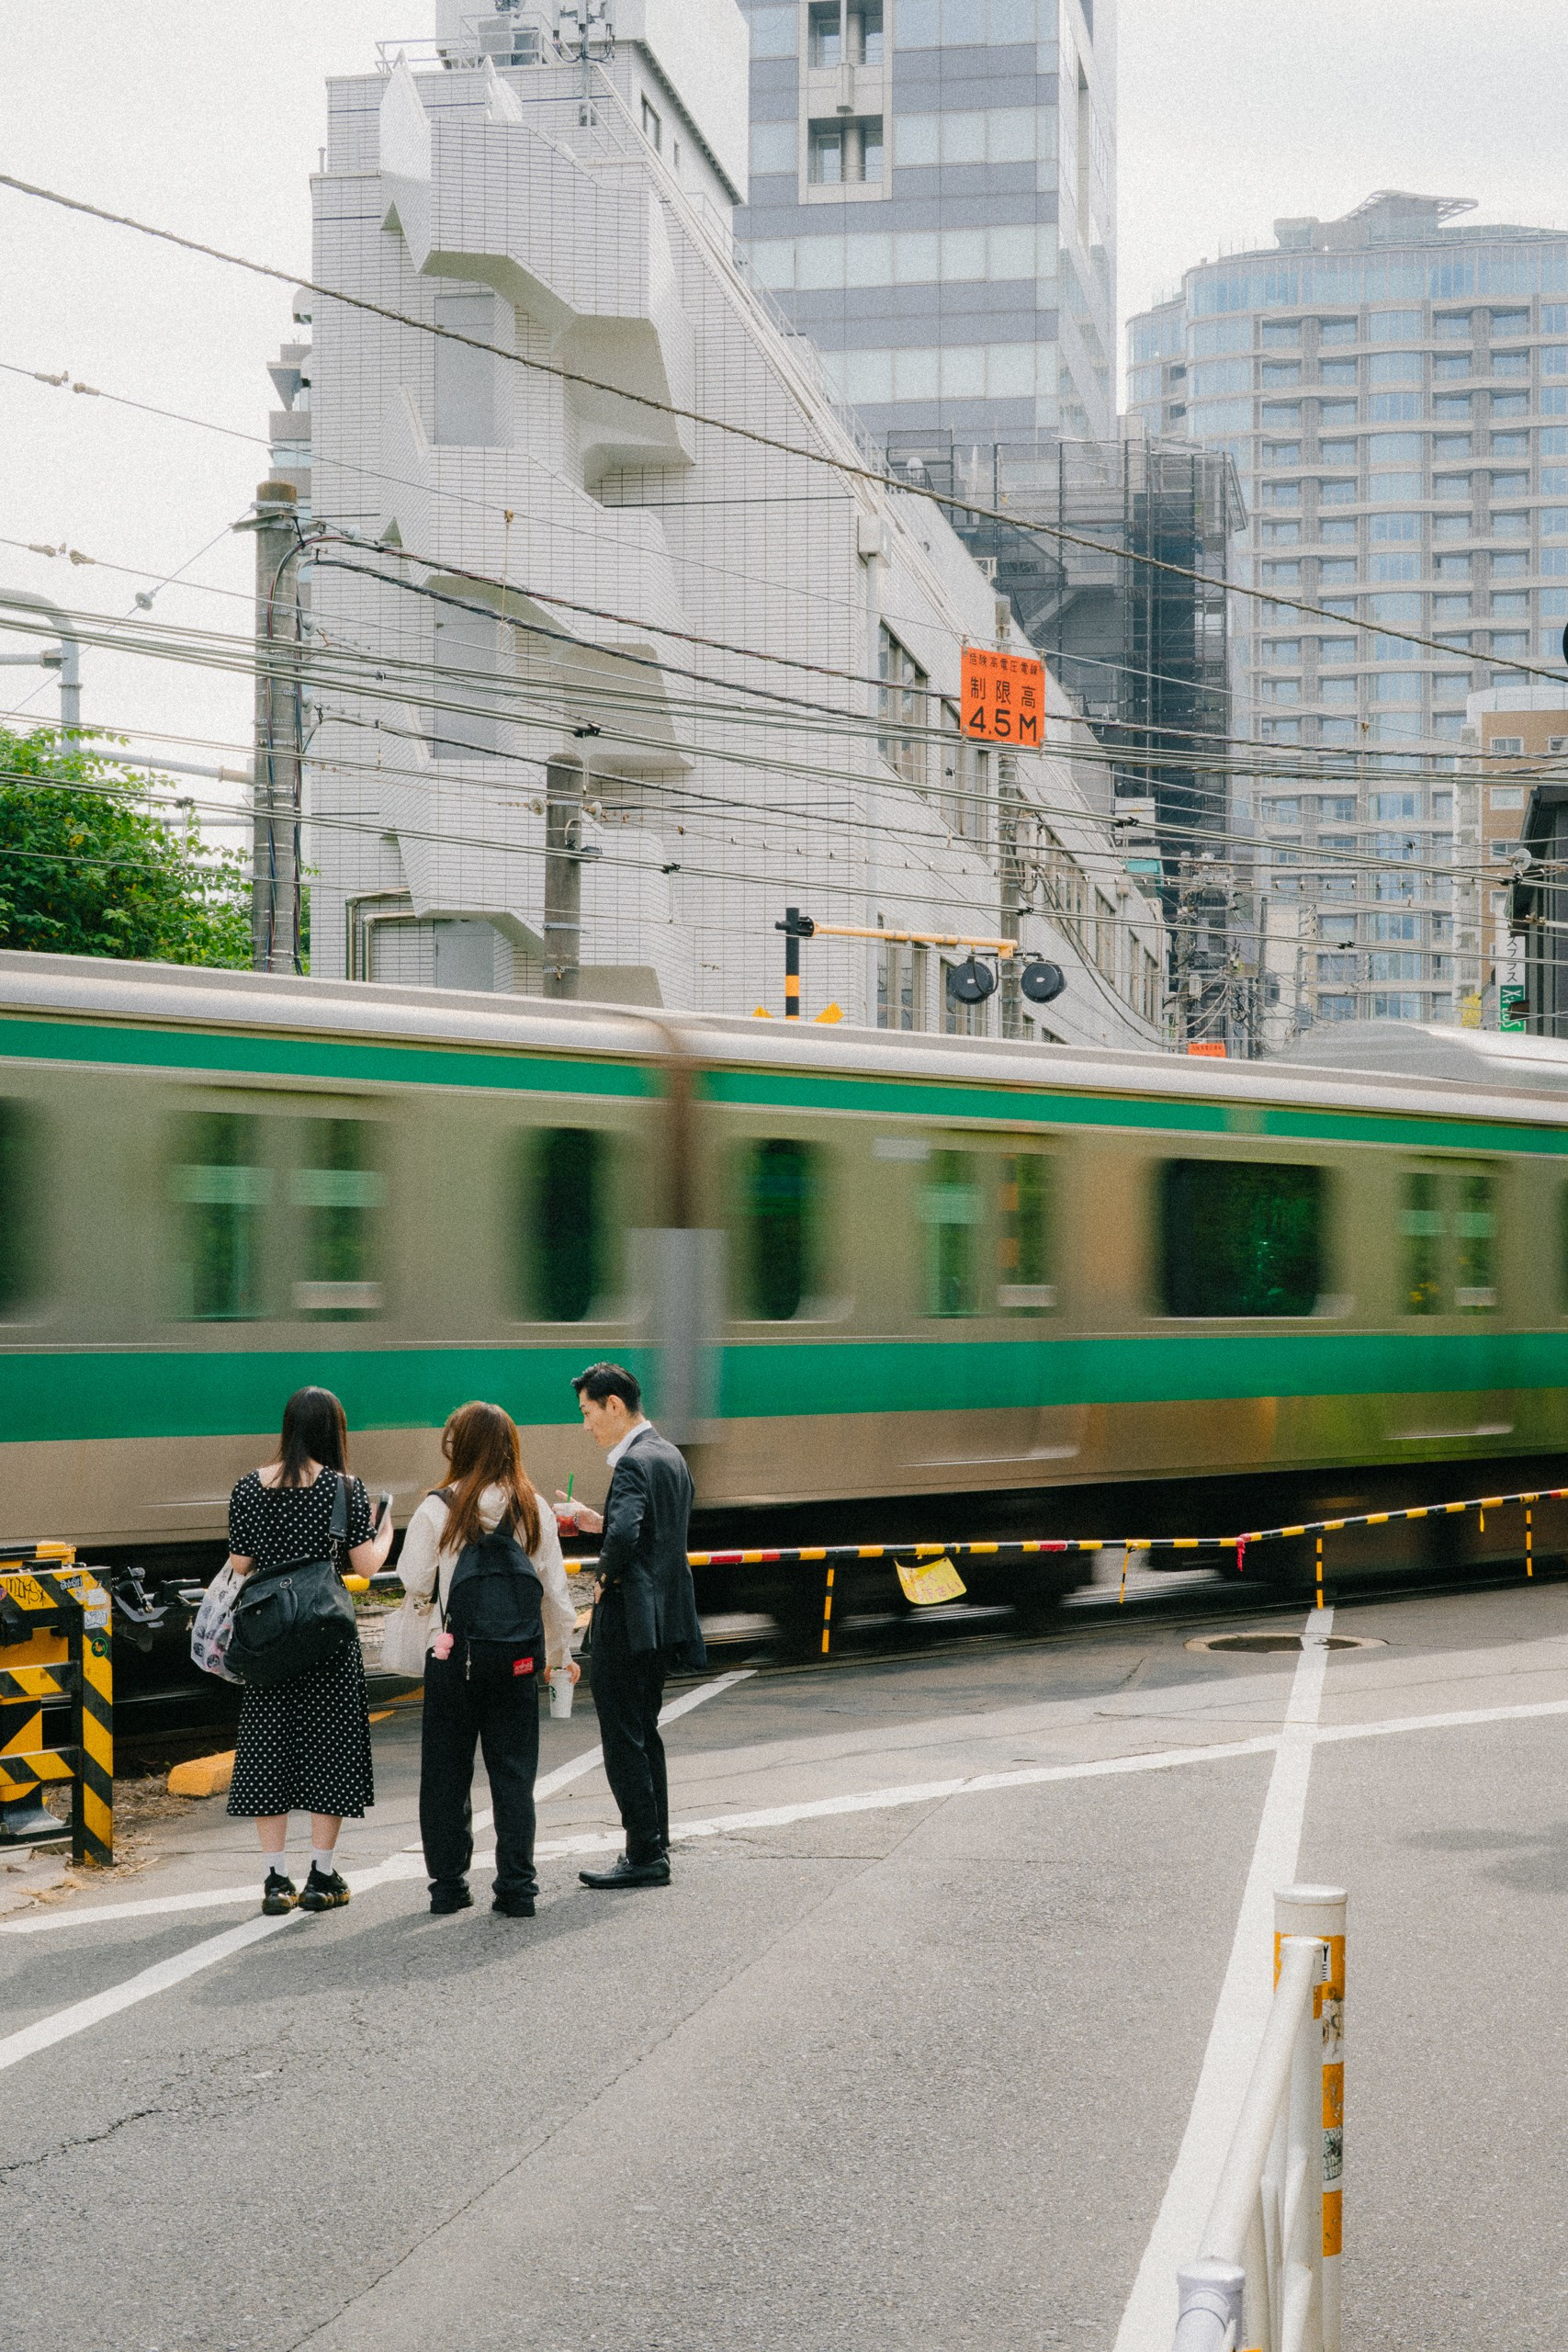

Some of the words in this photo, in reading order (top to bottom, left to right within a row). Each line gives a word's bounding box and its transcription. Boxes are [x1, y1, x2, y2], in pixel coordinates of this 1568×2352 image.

[969, 653, 1038, 676] 危険高電圧電線
[970, 676, 1036, 709] 制限高
[969, 706, 1037, 742] 4.5M
